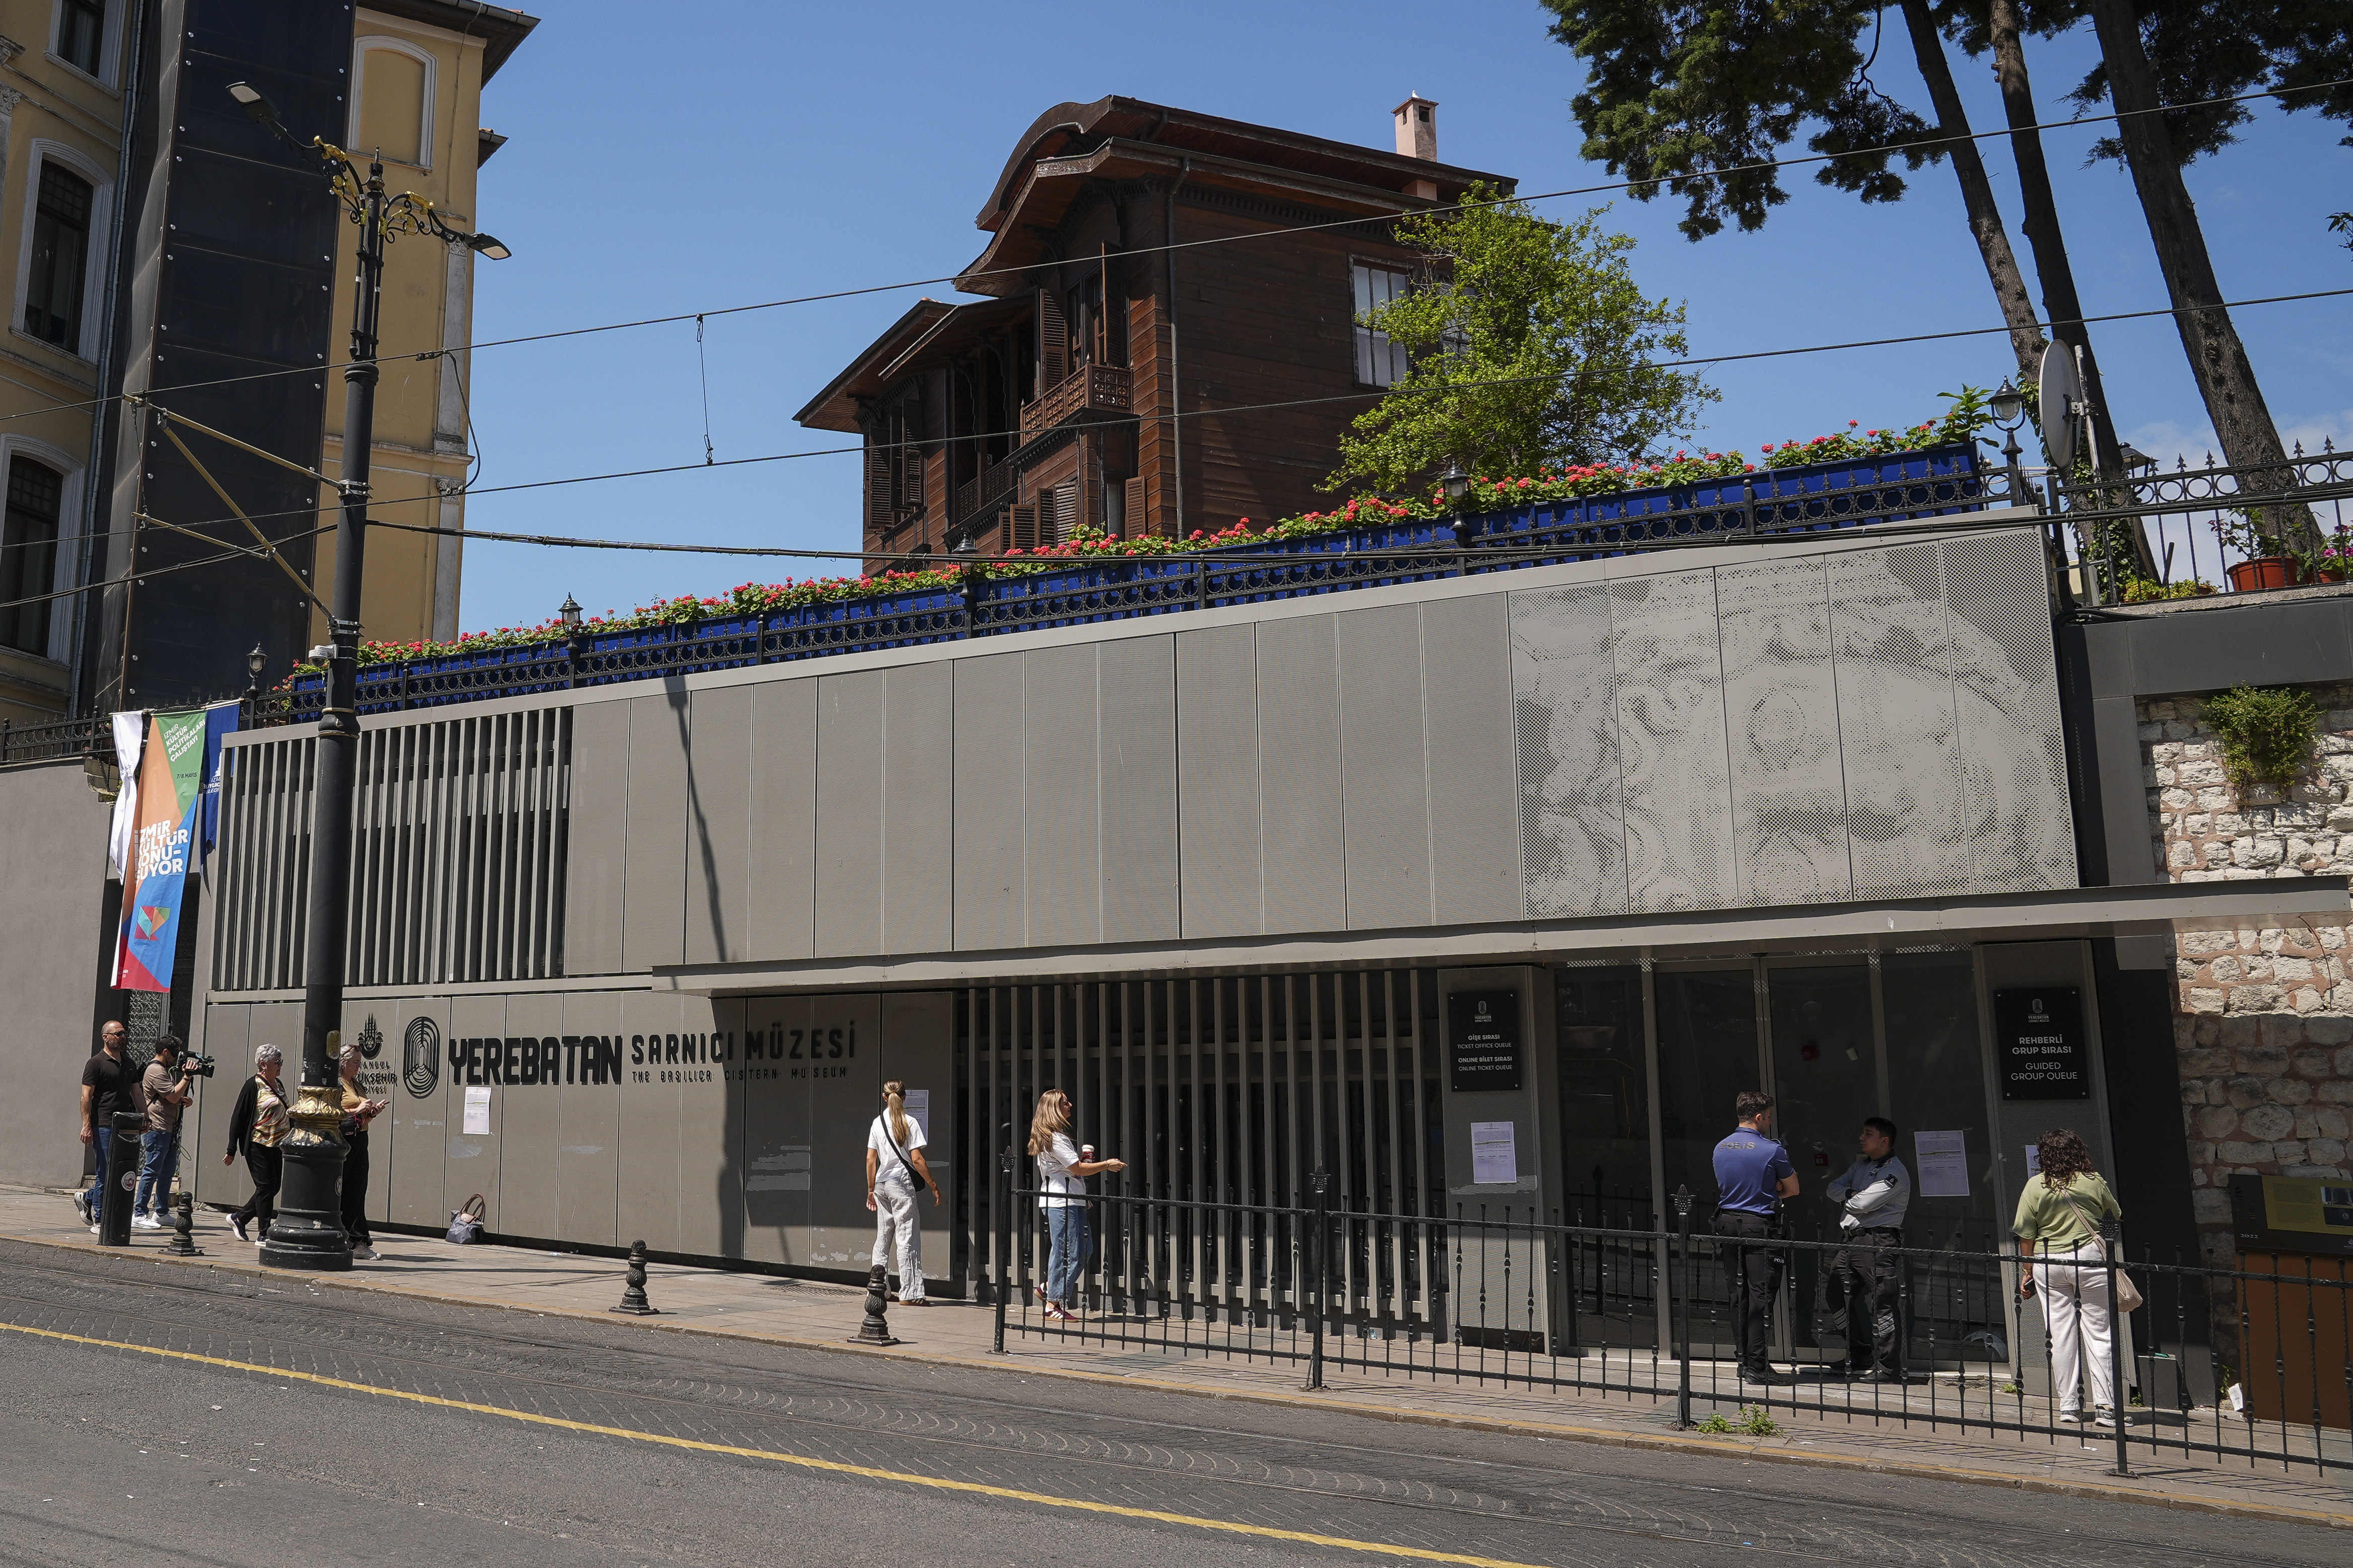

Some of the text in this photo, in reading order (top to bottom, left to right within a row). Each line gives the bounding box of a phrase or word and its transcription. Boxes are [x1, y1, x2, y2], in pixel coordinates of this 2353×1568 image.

[166, 726, 188, 746] KÜLTÜR
[170, 735, 198, 762] ÇALIŞTAYI
[1468, 1033, 1481, 1041] GİŞE
[2019, 1034, 2062, 1044] REHBERLİ
[631, 1020, 855, 1065] SARNICI MÜZESİ
[2041, 1046, 2072, 1054] SIRASI
[449, 1035, 622, 1085] YEREBATAN
[2025, 1062, 2061, 1070] GUIDED
[632, 1067, 847, 1083] THE BASILICA CISTERN MUSEUM
[2046, 1072, 2078, 1081] QUEUE
[1719, 1141, 1755, 1151] POLİS
